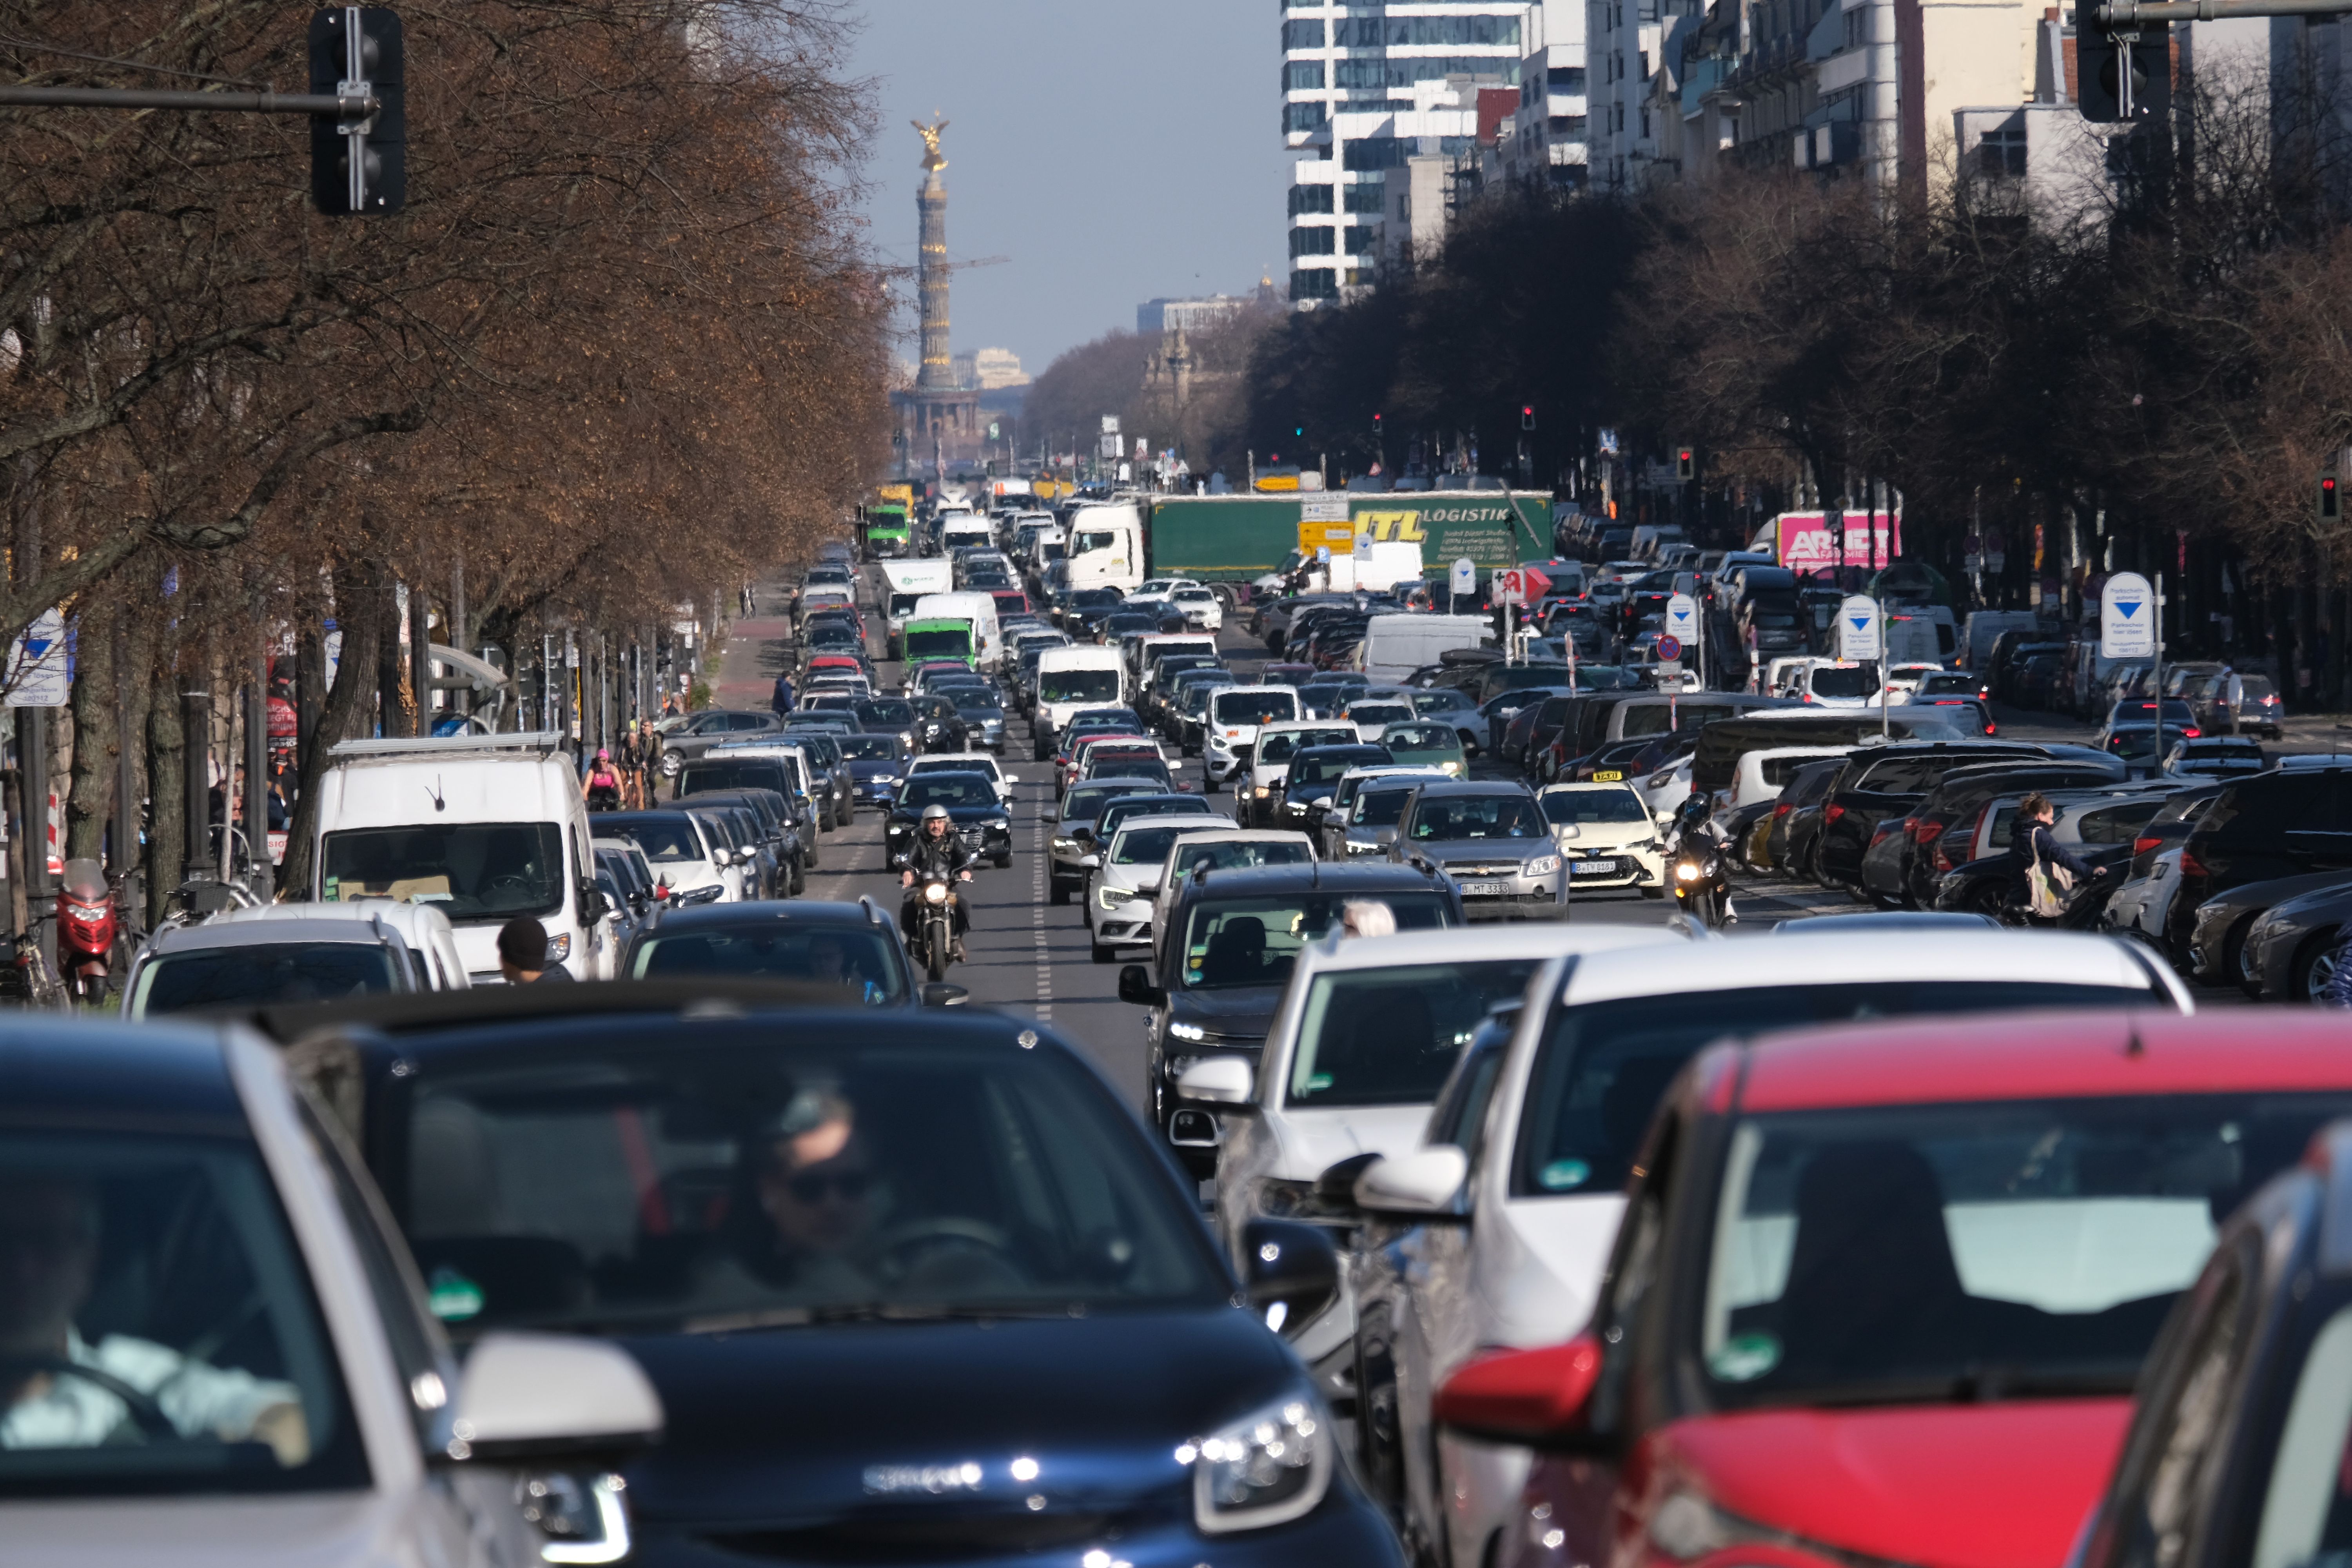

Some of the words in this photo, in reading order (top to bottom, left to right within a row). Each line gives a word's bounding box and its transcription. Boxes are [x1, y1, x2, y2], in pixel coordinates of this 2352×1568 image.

[1355, 511, 1427, 543] ITL
[1423, 508, 1509, 522] LOGISTIK
[1487, 885, 1508, 893] 3333
